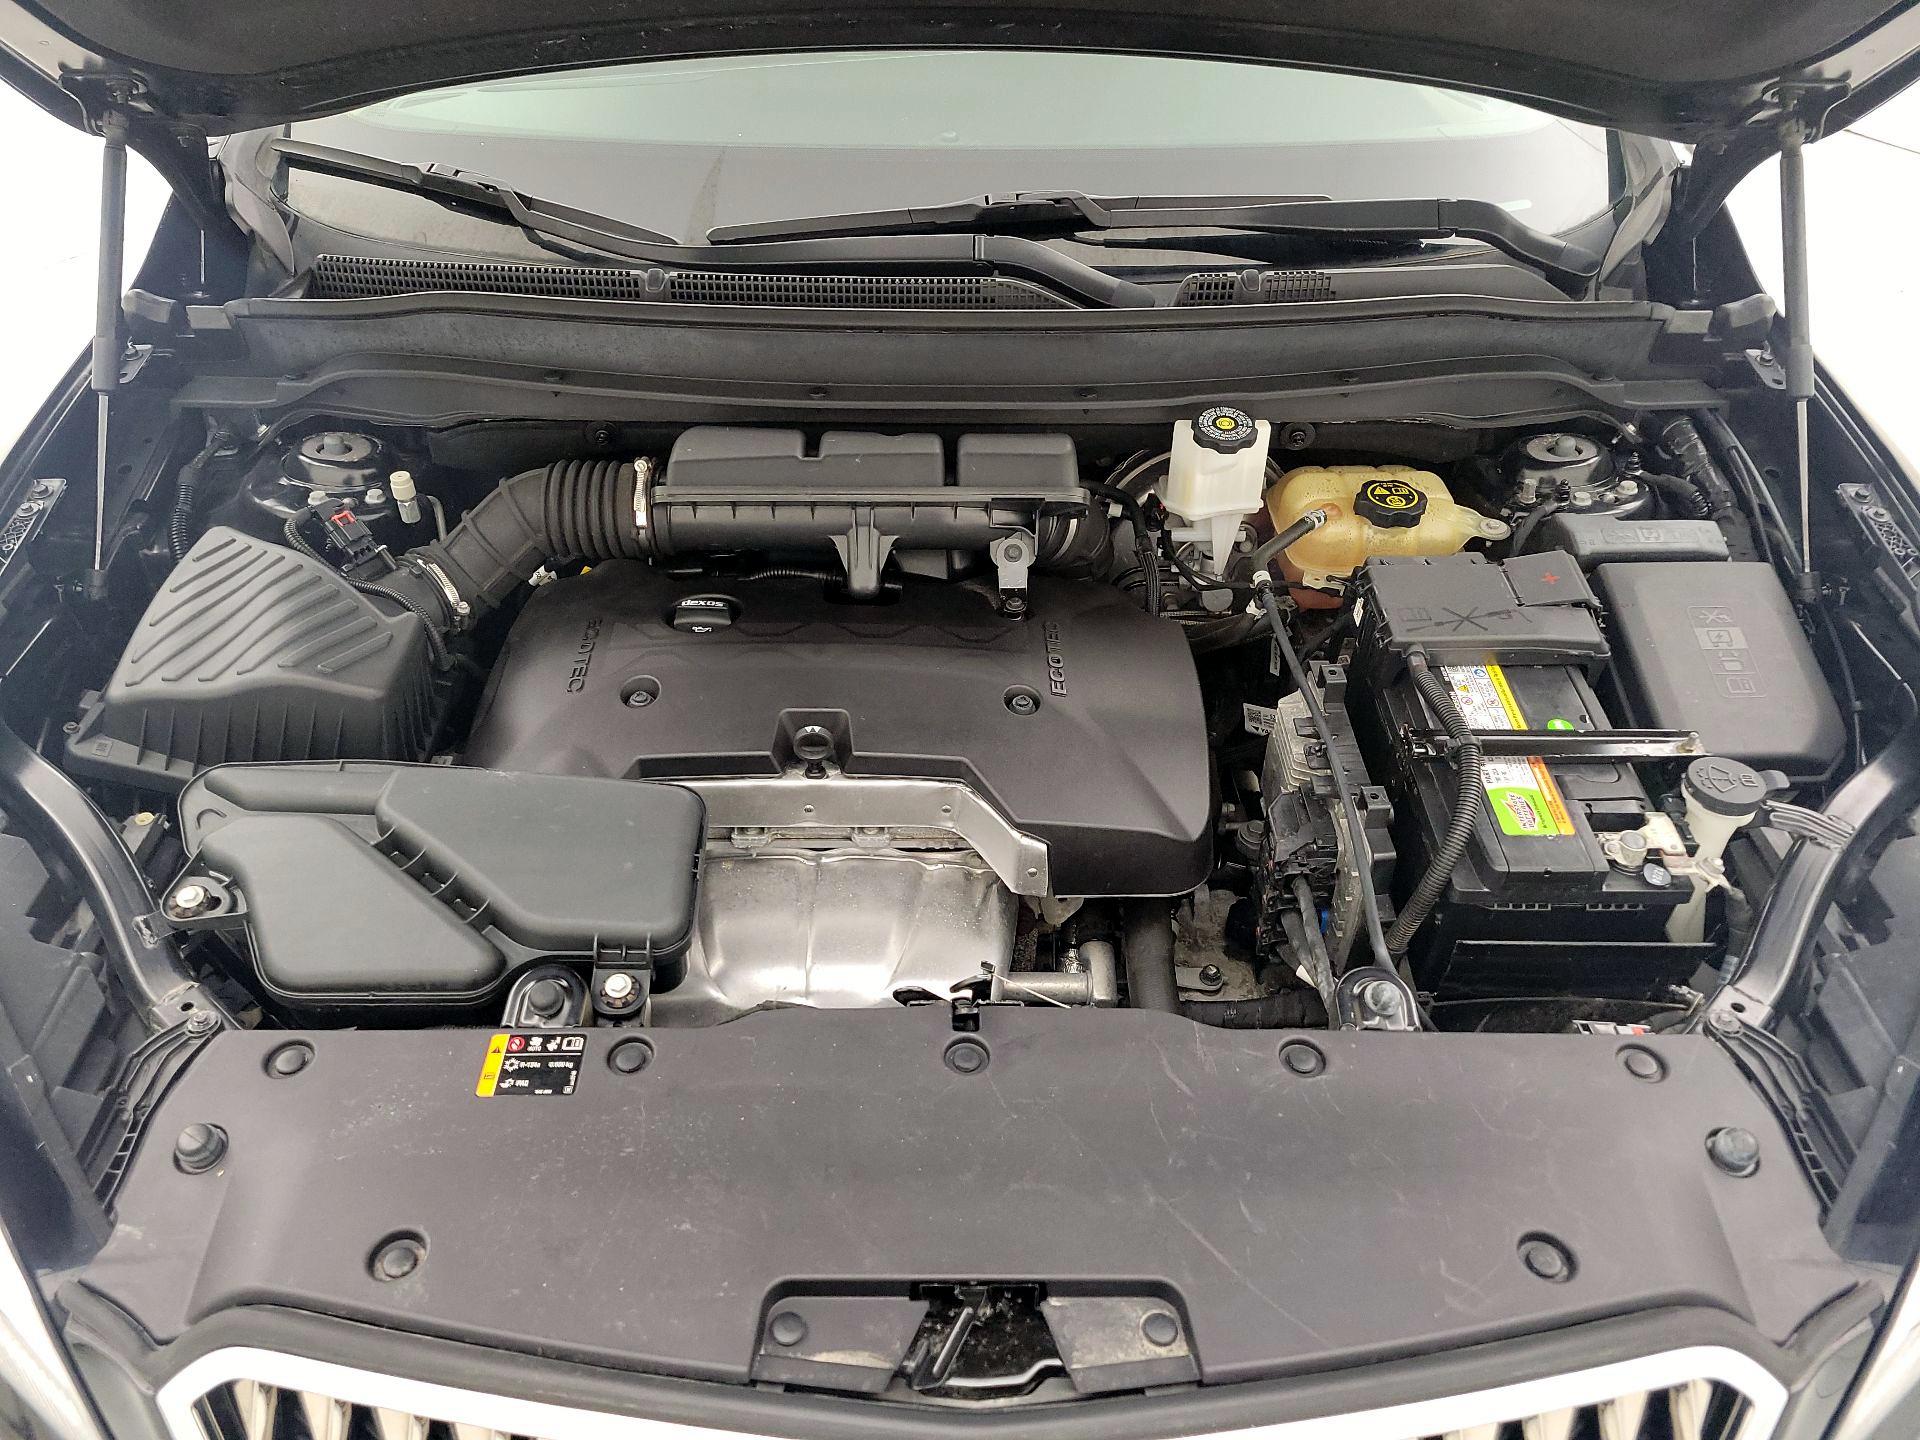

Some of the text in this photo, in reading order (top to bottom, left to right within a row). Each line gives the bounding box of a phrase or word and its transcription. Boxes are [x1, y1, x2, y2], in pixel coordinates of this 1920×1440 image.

[681, 599, 725, 607] dexos
[567, 617, 603, 693] ECOTEC
[1043, 621, 1067, 697] ECOTEC
